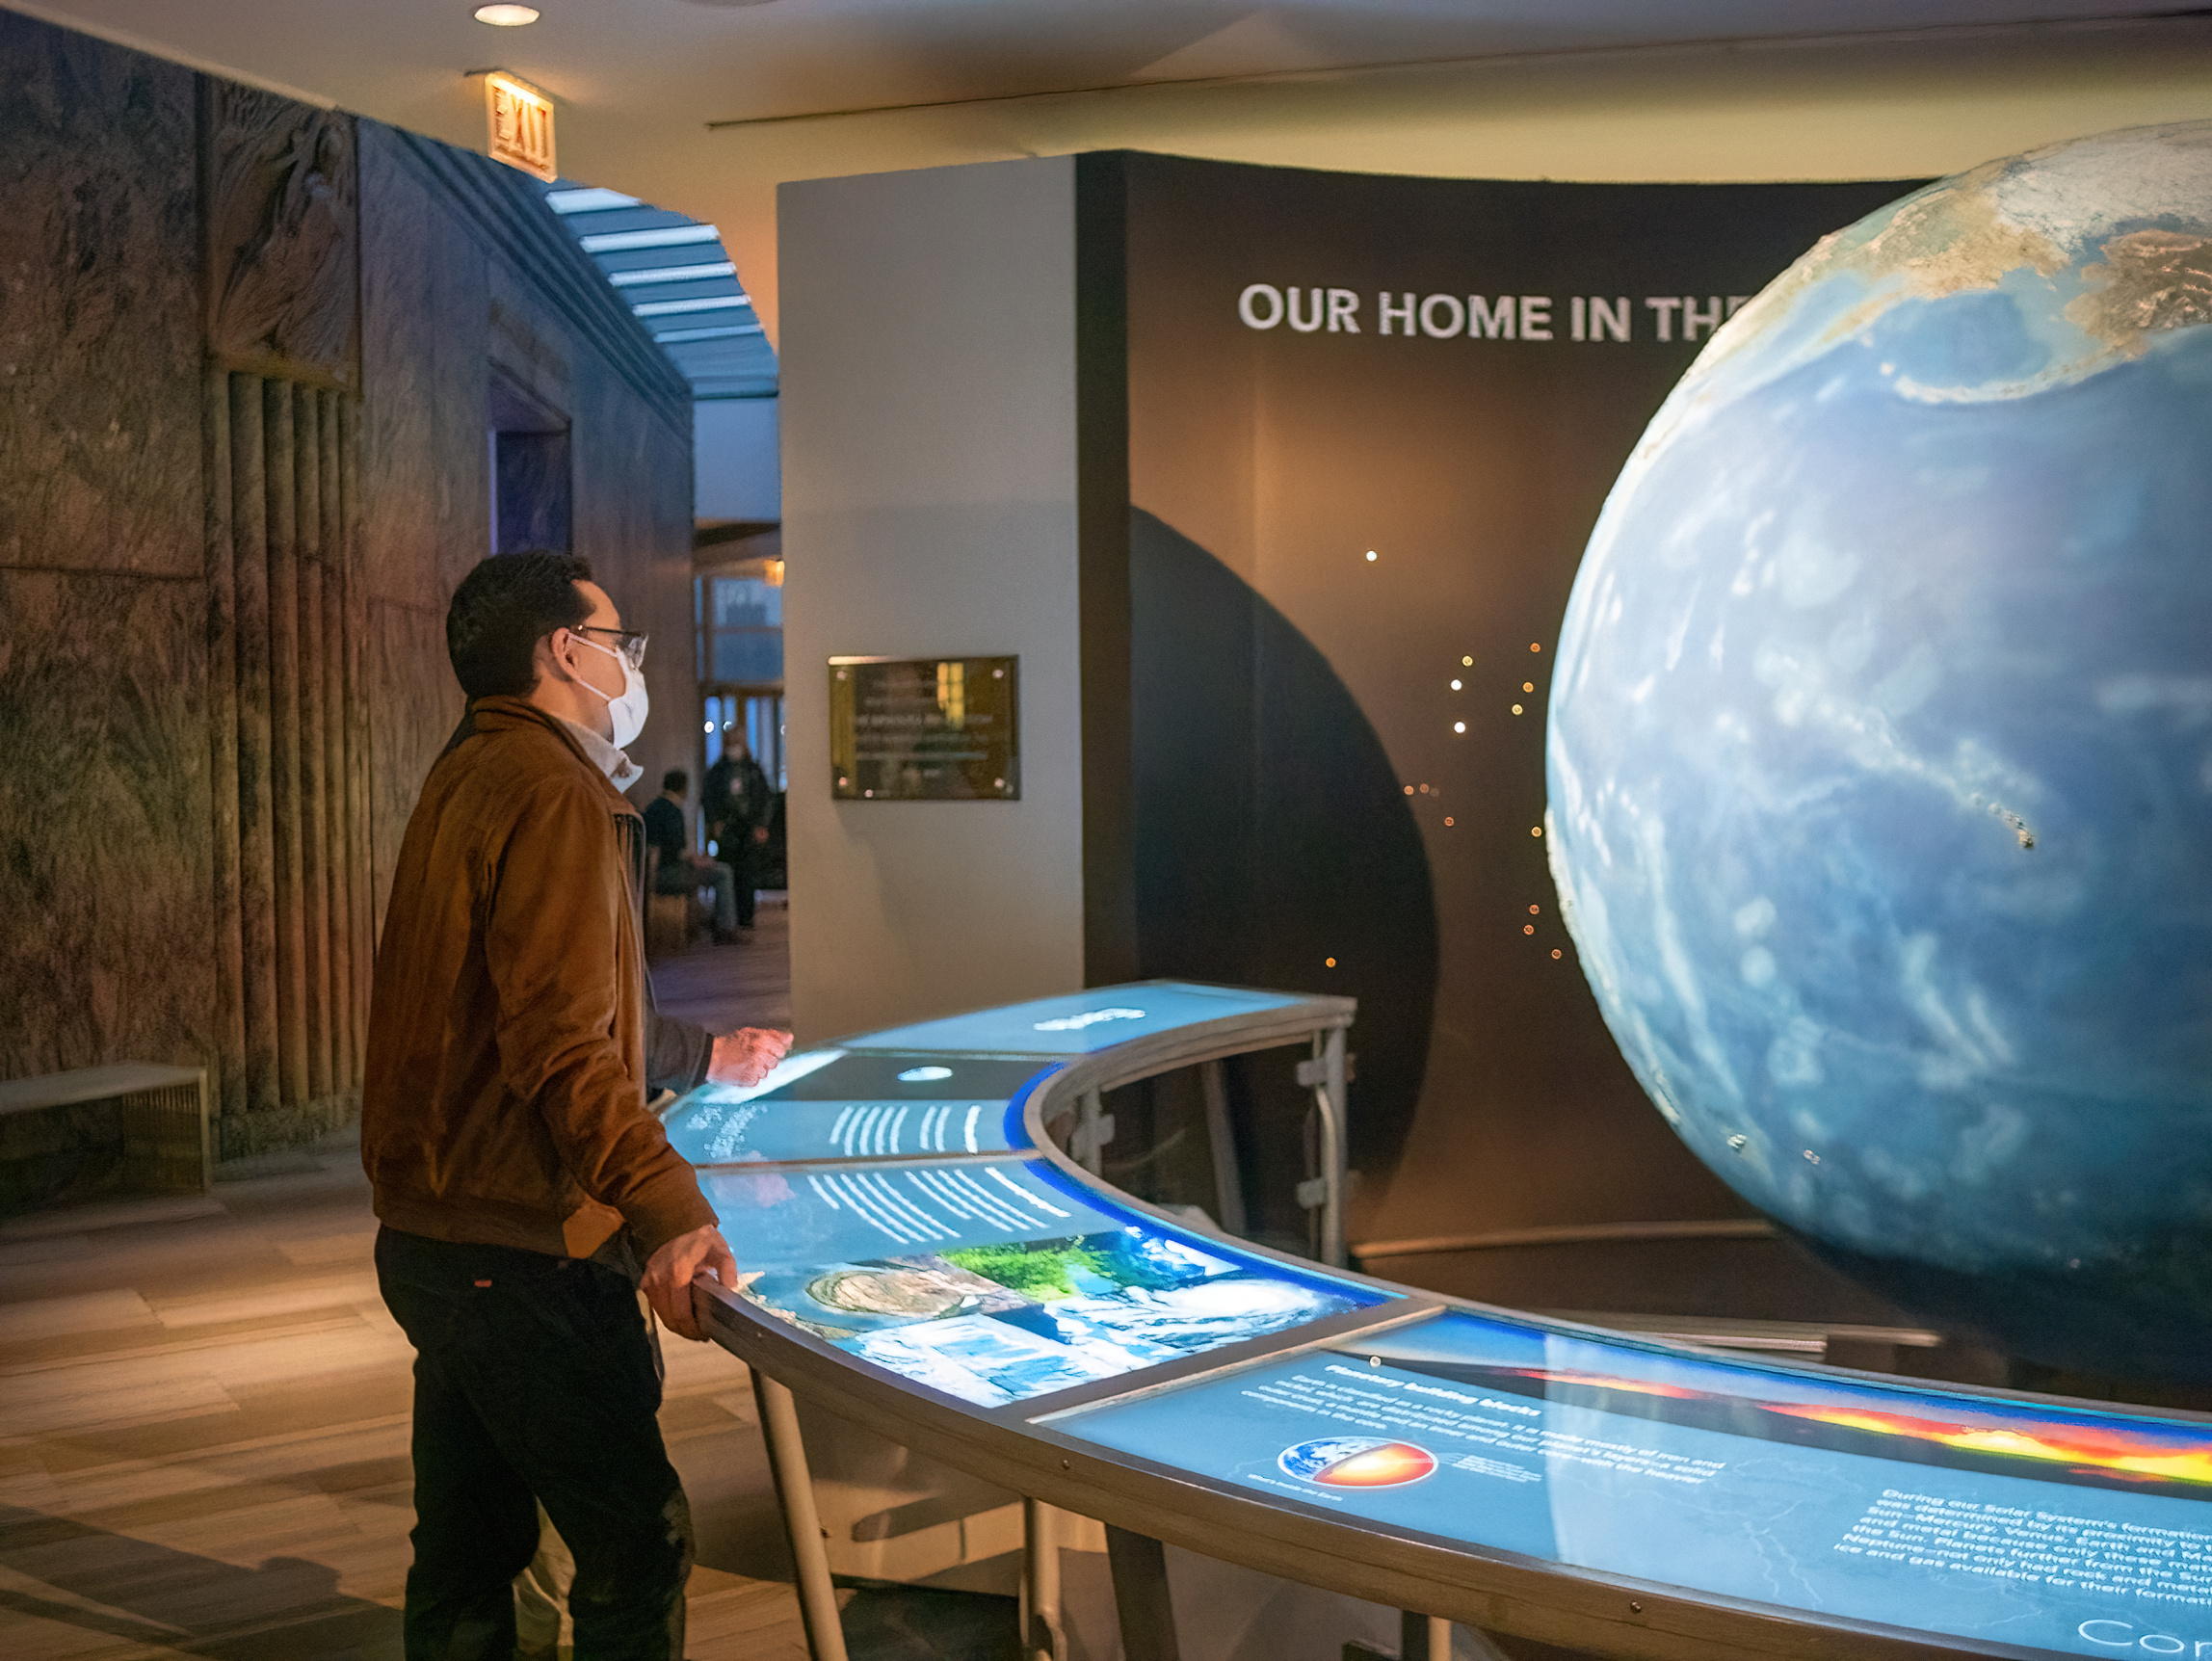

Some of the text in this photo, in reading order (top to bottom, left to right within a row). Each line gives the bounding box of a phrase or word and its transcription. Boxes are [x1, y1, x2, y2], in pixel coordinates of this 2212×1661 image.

[492, 84, 548, 159] EXIT
[1239, 284, 1360, 333] OUR
[1378, 291, 1553, 341] HOME
[1570, 297, 1631, 342] IN
[1883, 1490, 1944, 1505] During
[1914, 1505, 2023, 1528] determined
[1853, 1525, 1883, 1534] the
[2139, 1568, 2172, 1577] the
[1859, 1517, 1898, 1526] and
[1963, 1531, 2048, 1548] because
[2054, 1545, 2098, 1558] only
[2076, 1536, 2129, 1550] Earth
[2136, 1546, 2175, 1556] and
[1866, 1550, 1906, 1560] and
[1974, 1555, 2016, 1567] only
[2112, 1575, 2151, 1586] and
